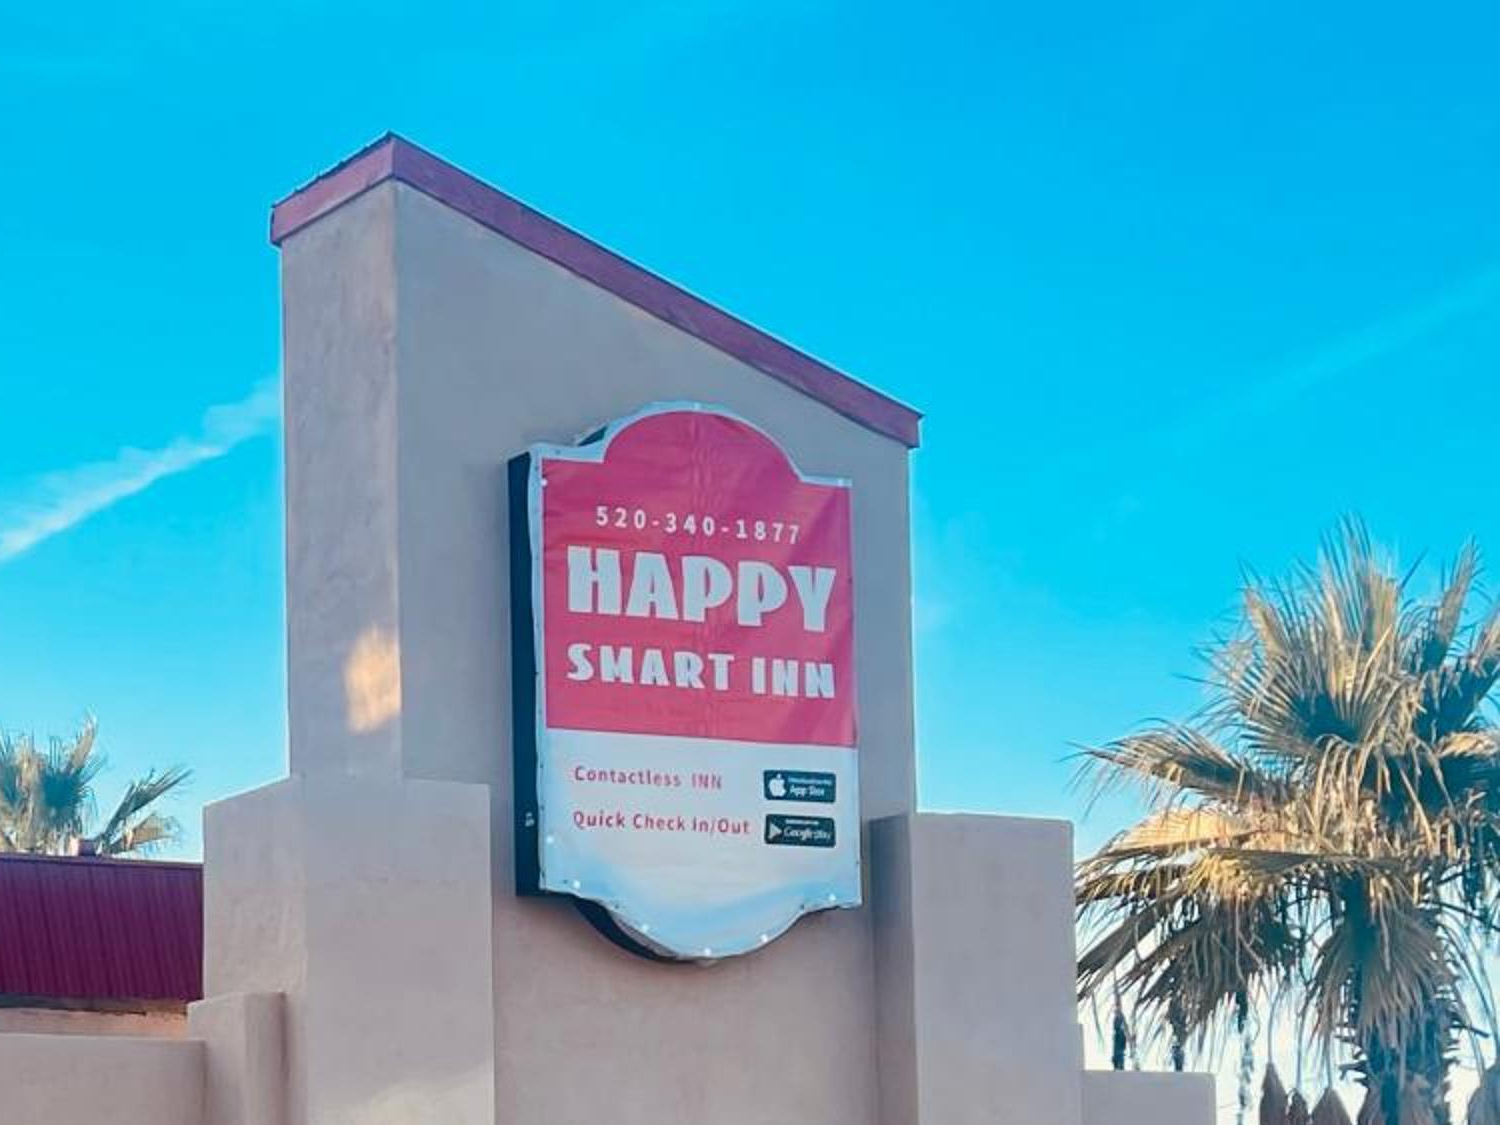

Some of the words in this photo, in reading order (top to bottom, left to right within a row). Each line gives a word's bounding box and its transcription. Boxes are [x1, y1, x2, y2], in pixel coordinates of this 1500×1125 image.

[596, 505, 800, 545] 520-340-1877
[567, 544, 837, 633] HAPPY
[566, 643, 736, 690] SMART
[751, 656, 836, 699] INN
[574, 765, 682, 787] Contactless
[691, 773, 722, 790] INN
[572, 810, 625, 830] Quick
[632, 813, 686, 832] Check
[691, 815, 751, 836] In/Out
